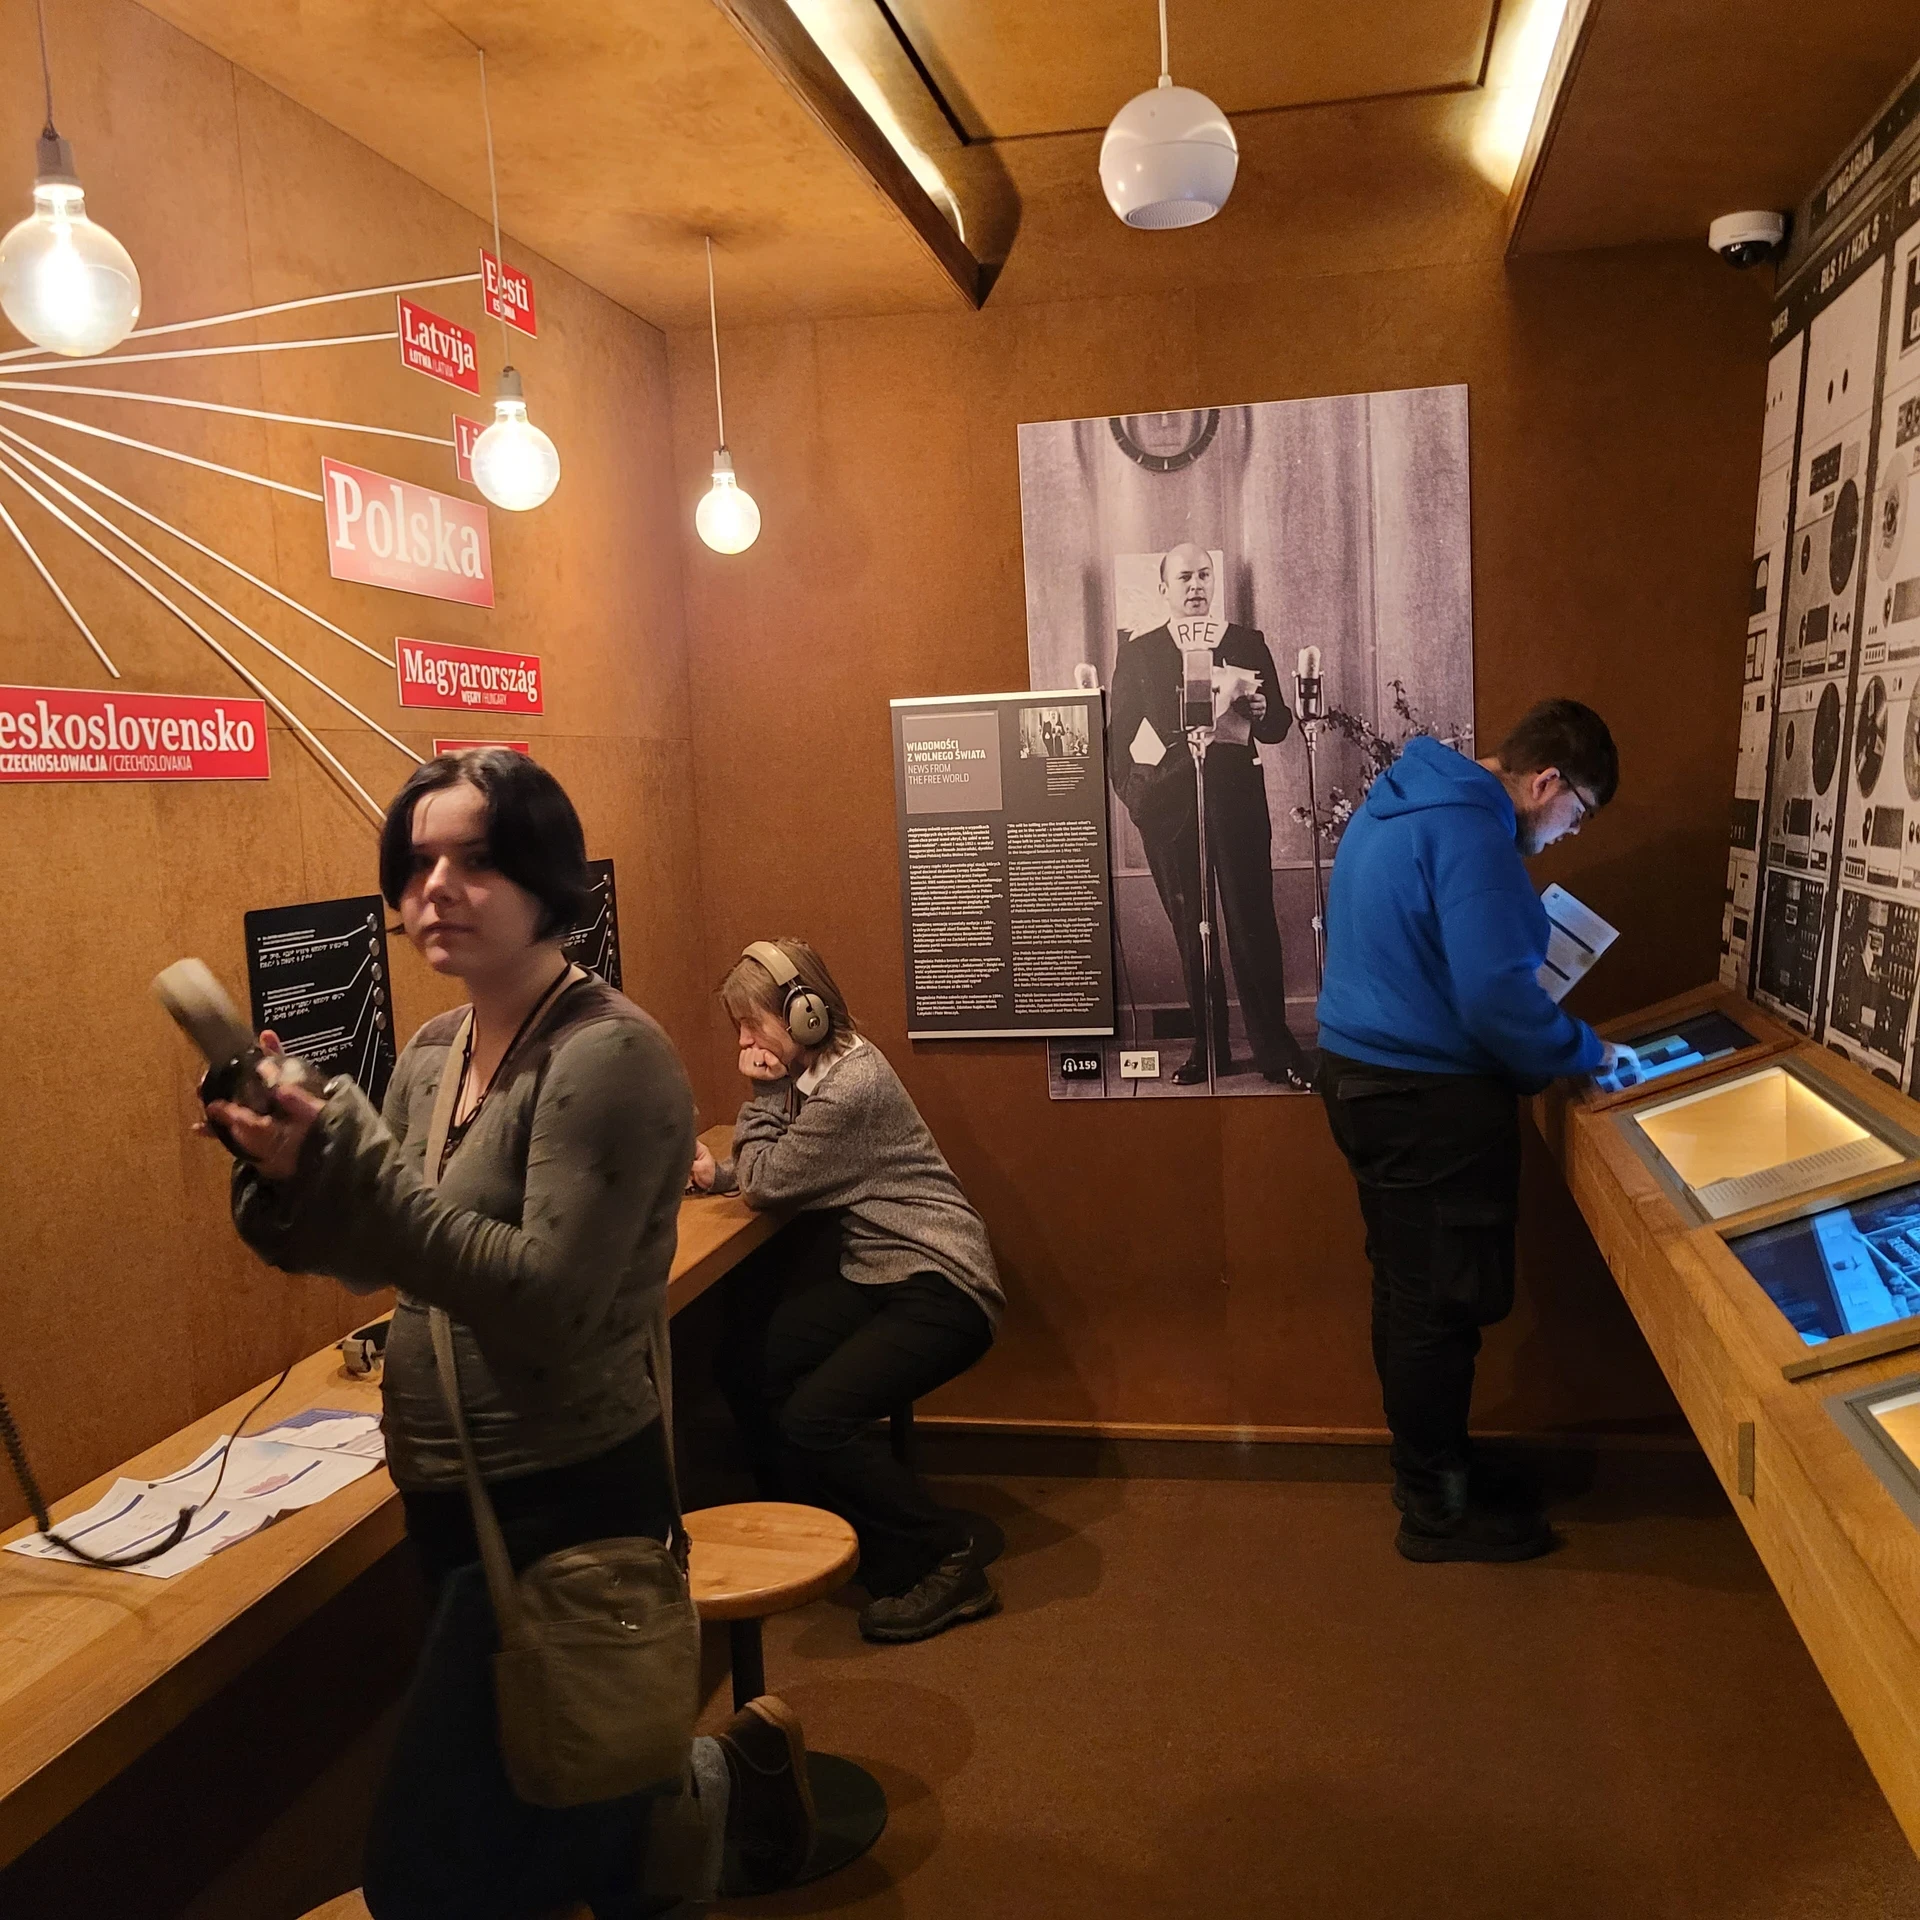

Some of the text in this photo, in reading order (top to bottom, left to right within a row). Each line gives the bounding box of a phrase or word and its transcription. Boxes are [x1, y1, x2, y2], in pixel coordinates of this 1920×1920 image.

[484, 259, 530, 312] Eesti
[403, 306, 476, 375] Latvija
[329, 470, 484, 580] Polska
[1177, 622, 1219, 644] RFE
[403, 648, 537, 702] Magyarország
[906, 738, 959, 752] WIADOMOŚCI
[907, 748, 986, 762] Z WOLNEGO ŚWIATA
[908, 763, 951, 774] NEWS FROM
[908, 773, 970, 785] THE FREE WORLD
[1078, 1060, 1097, 1070] 159
